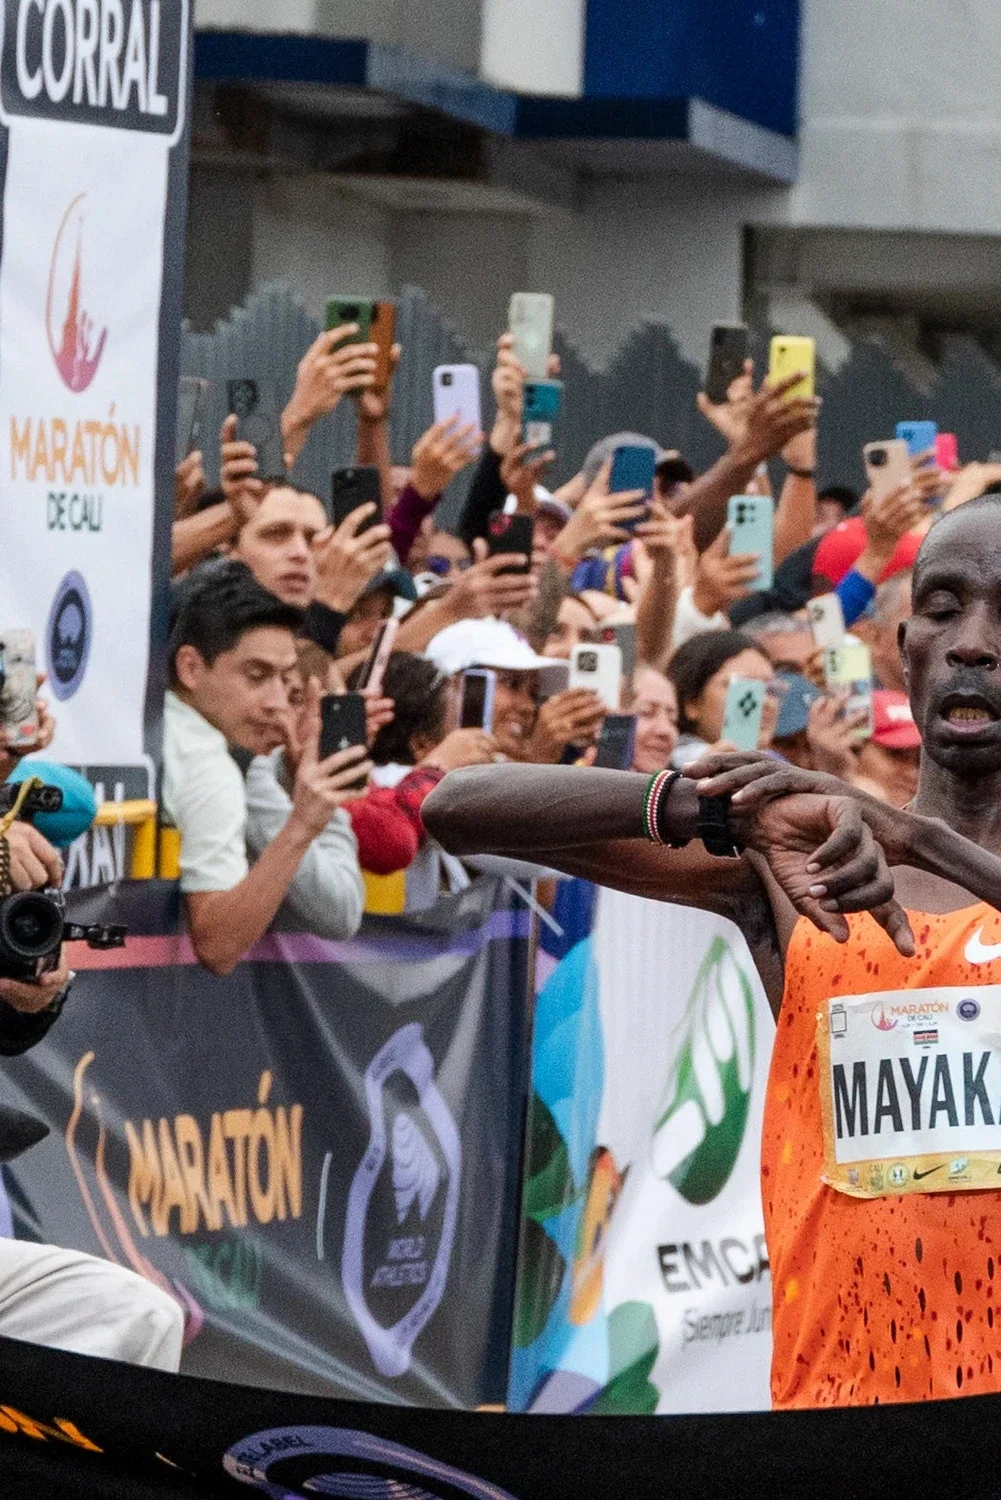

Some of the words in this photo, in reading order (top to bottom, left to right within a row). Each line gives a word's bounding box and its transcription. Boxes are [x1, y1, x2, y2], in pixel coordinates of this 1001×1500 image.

[16, 0, 168, 116] CORRAL
[9, 400, 141, 488] MARATÓN
[46, 490, 66, 532] DE
[70, 491, 102, 532] CALI
[890, 1000, 949, 1016] MARATÓN
[918, 1013, 933, 1021] CALI
[124, 1069, 304, 1238] MARATÓN
